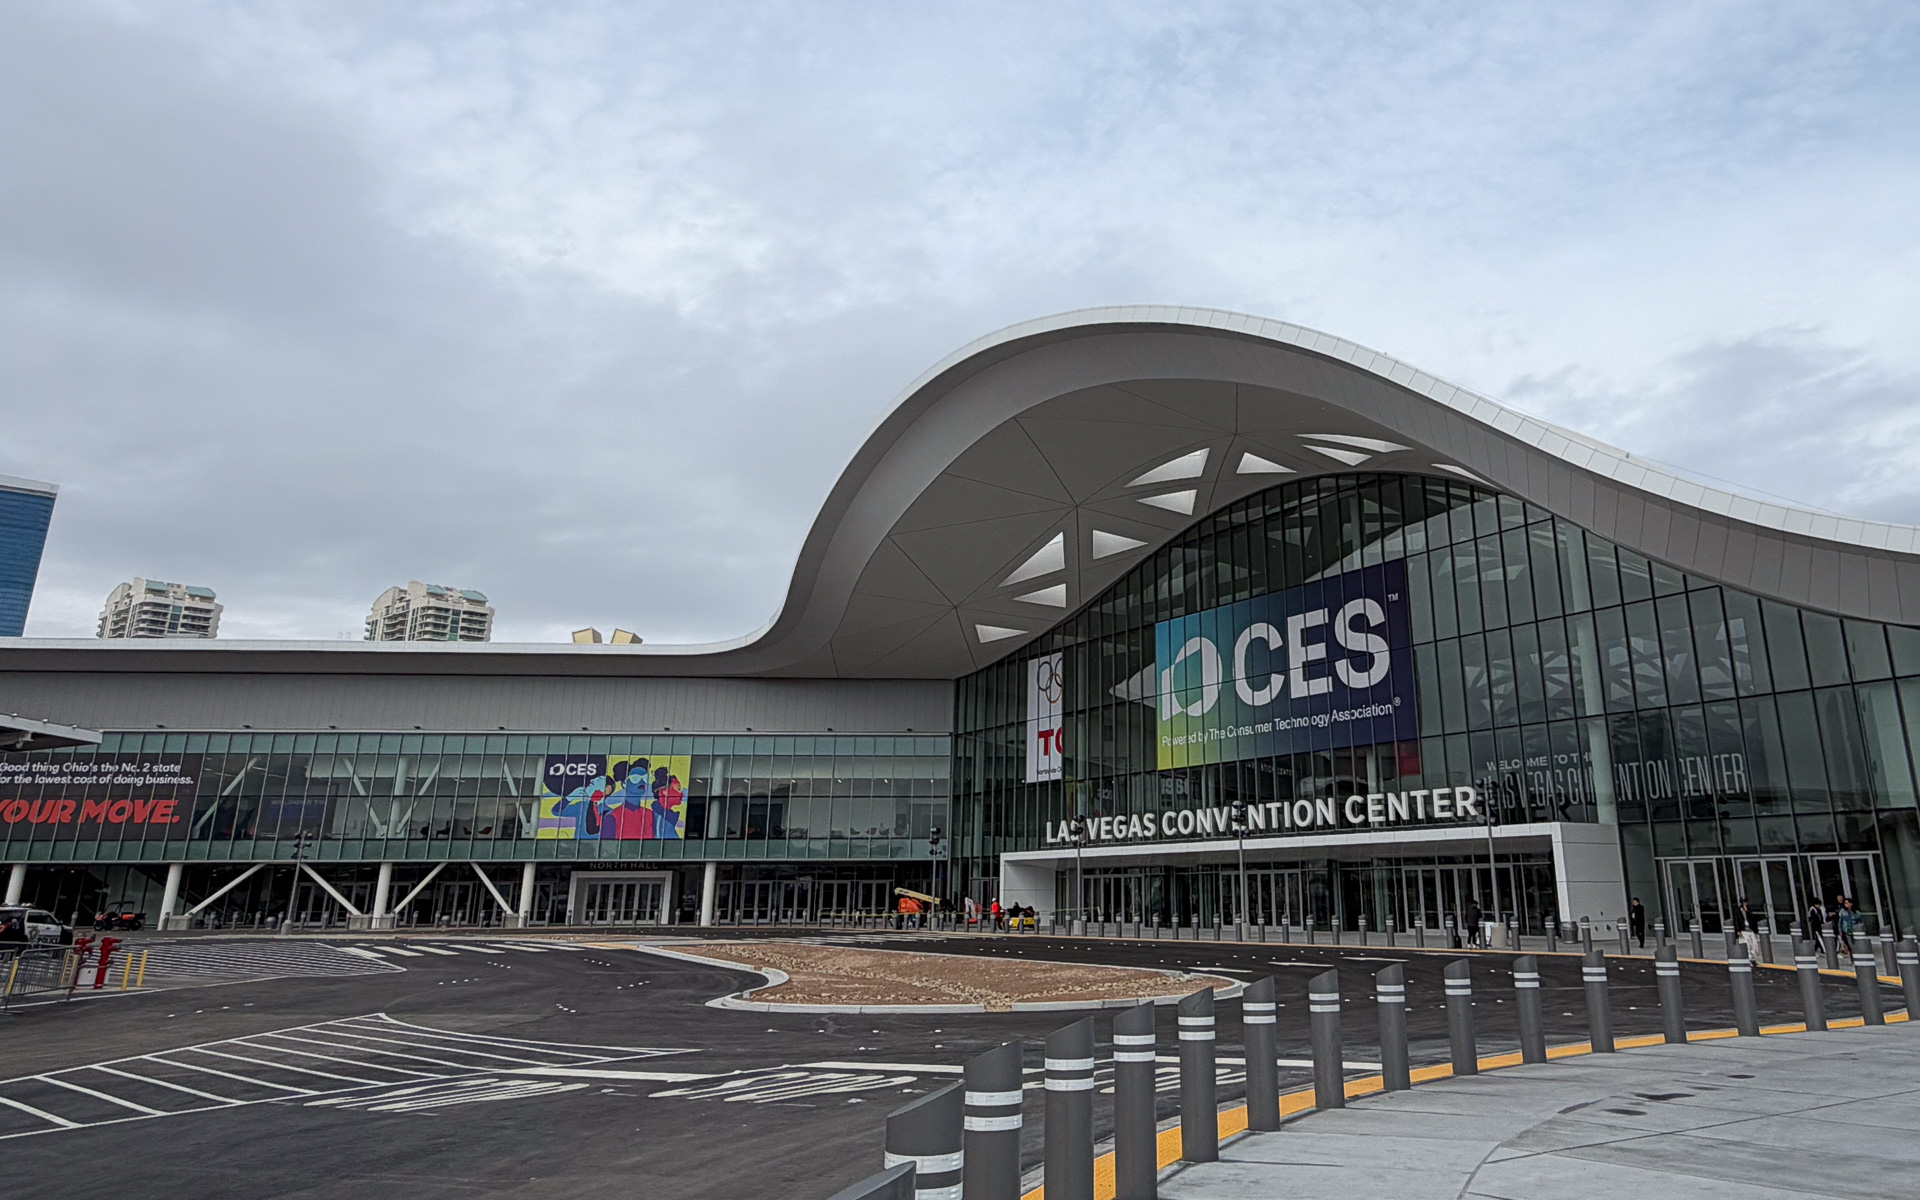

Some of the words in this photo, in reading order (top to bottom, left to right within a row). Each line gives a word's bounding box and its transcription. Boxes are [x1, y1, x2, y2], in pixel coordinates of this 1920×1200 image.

[1234, 598, 1390, 706] CES
[1198, 731, 1208, 744] by
[1209, 728, 1226, 740] The
[1274, 714, 1329, 730] Technoogy
[0, 762, 30, 772] Good
[32, 762, 60, 774] thing
[62, 762, 98, 772] Ohio's
[101, 762, 119, 772] the
[143, 763, 150, 772] 2
[152, 763, 181, 772] state
[566, 763, 597, 776] CES
[0, 773, 12, 784] or
[14, 774, 33, 784] the
[35, 774, 72, 784] lowest
[73, 776, 98, 784] cost
[99, 774, 112, 784] of
[113, 774, 144, 787] doing
[145, 774, 194, 784] business.
[77, 799, 180, 824] MOVE.
[1046, 819, 1082, 843] LAS
[1086, 813, 1156, 840] VEGAS
[1162, 797, 1336, 836] CONVENTION
[1345, 786, 1479, 824] CENTER
[589, 862, 627, 870] NORTH
[630, 862, 658, 870] HALL
